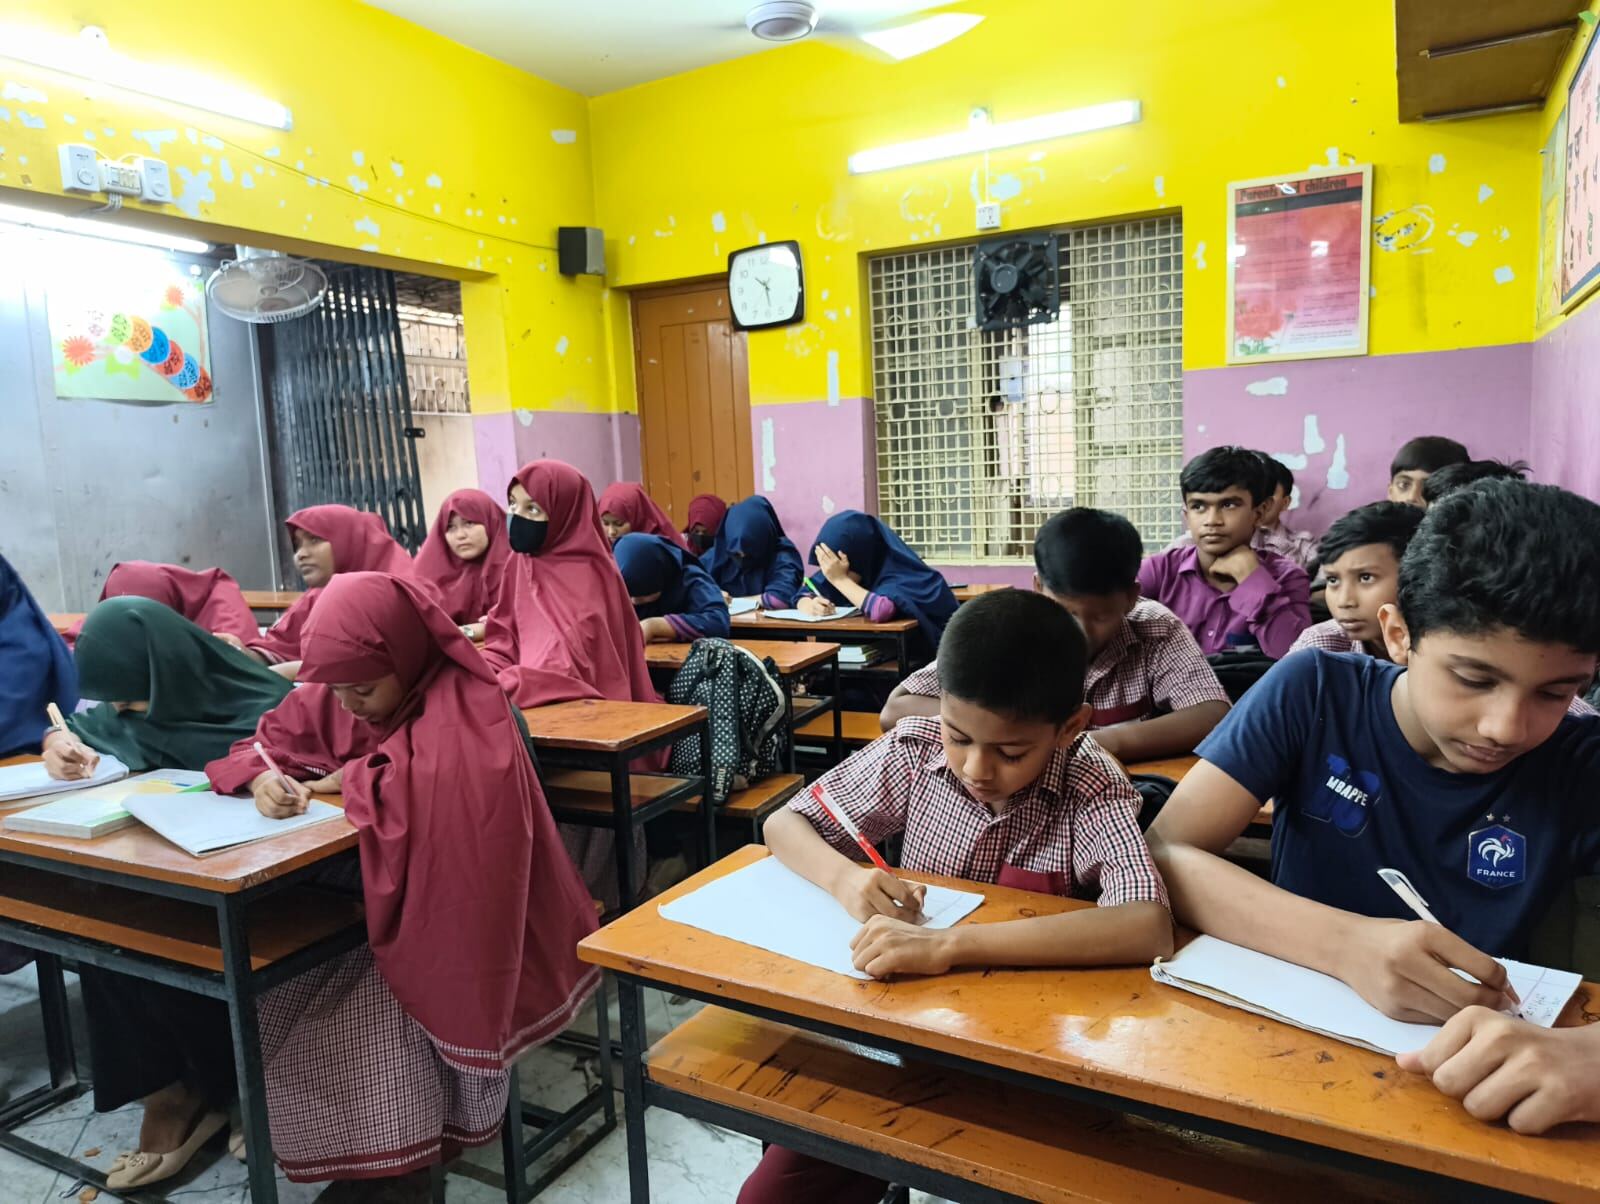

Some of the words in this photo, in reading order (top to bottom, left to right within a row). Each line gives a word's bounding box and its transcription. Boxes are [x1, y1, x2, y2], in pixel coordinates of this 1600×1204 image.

[740, 270, 749, 280] 10
[1326, 775, 1368, 807] MBAPPE
[1476, 868, 1516, 878] FRANCE
